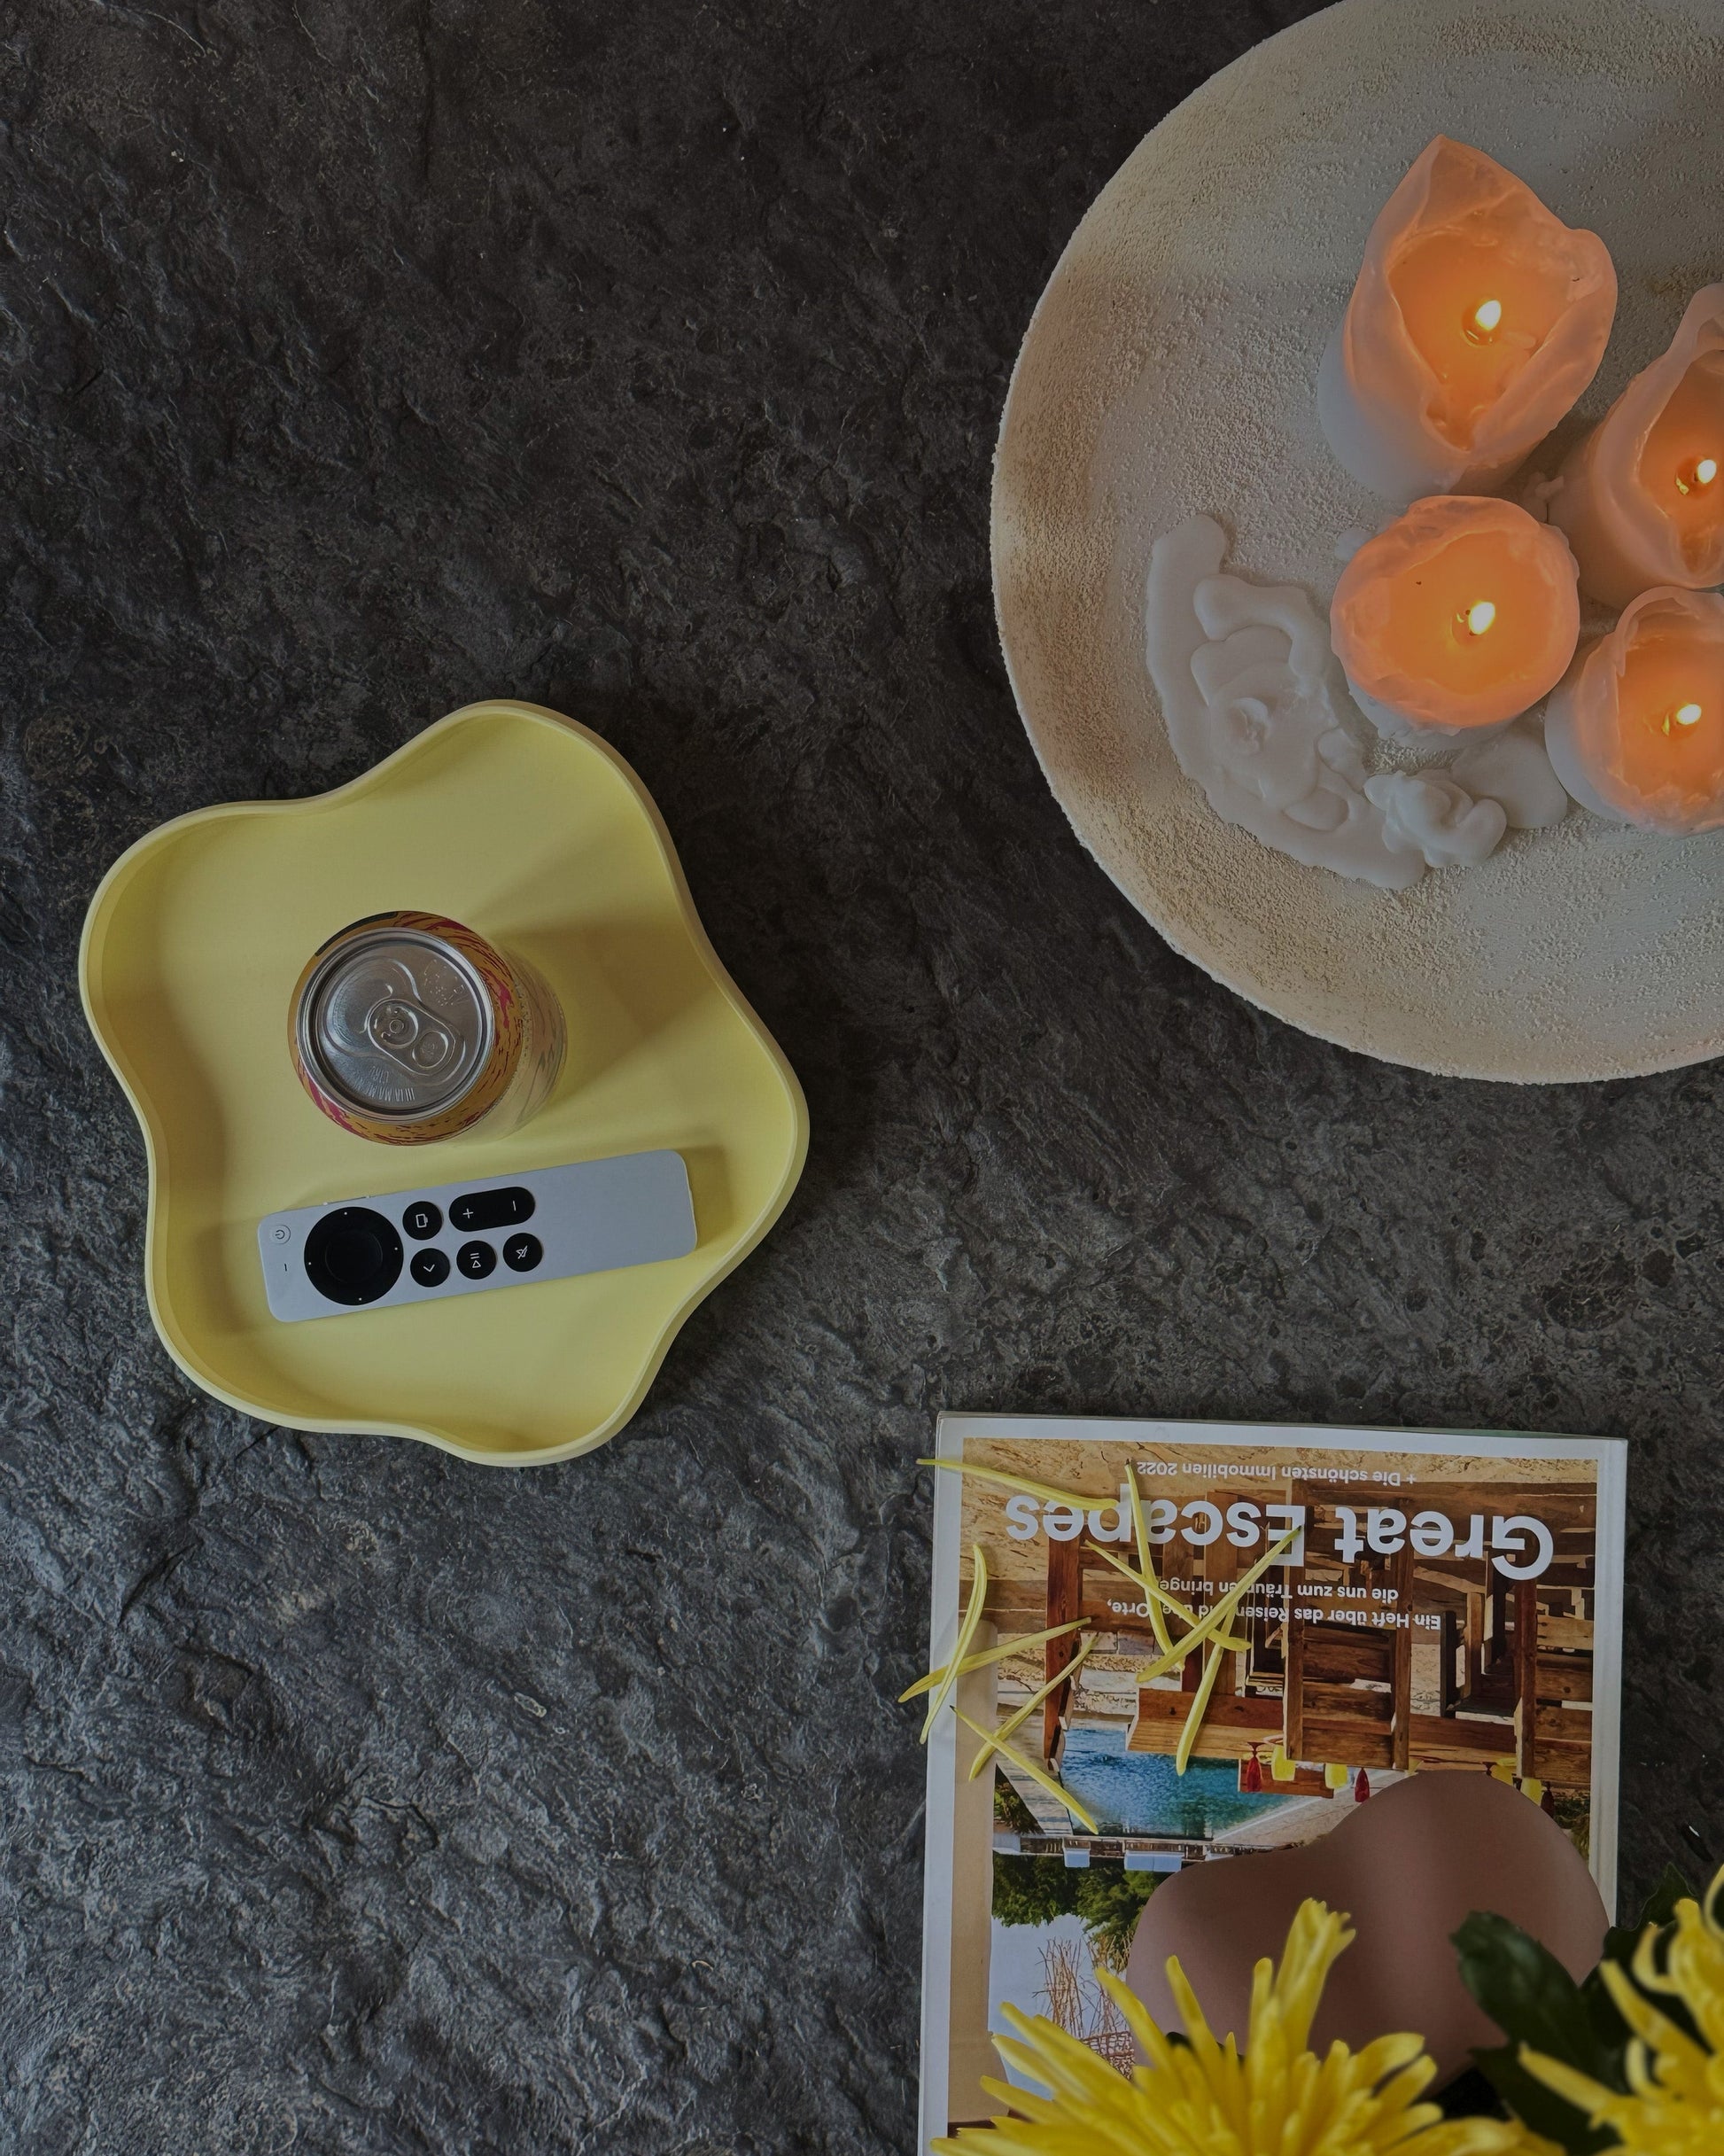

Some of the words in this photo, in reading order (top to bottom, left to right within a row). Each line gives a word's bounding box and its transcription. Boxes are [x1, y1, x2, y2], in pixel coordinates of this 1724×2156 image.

[1137, 1462, 1177, 1475] 2022
[1182, 1463, 1276, 1480] Immobilien
[1282, 1467, 1368, 1483] schönsten
[1372, 1471, 1401, 1486] Die
[1006, 1483, 1305, 1567] Escapes
[1334, 1506, 1554, 1580] Great
[1160, 1577, 1214, 1596] bringe
[1297, 1584, 1332, 1597] zum
[1337, 1586, 1367, 1598] uns
[1371, 1588, 1399, 1604] die
[1107, 1599, 1149, 1617] Orte,
[1236, 1607, 1289, 1622] Reisen
[1293, 1608, 1324, 1623] das
[1327, 1609, 1367, 1626] über
[1371, 1612, 1409, 1628] Heft
[1415, 1615, 1441, 1630] Ein
